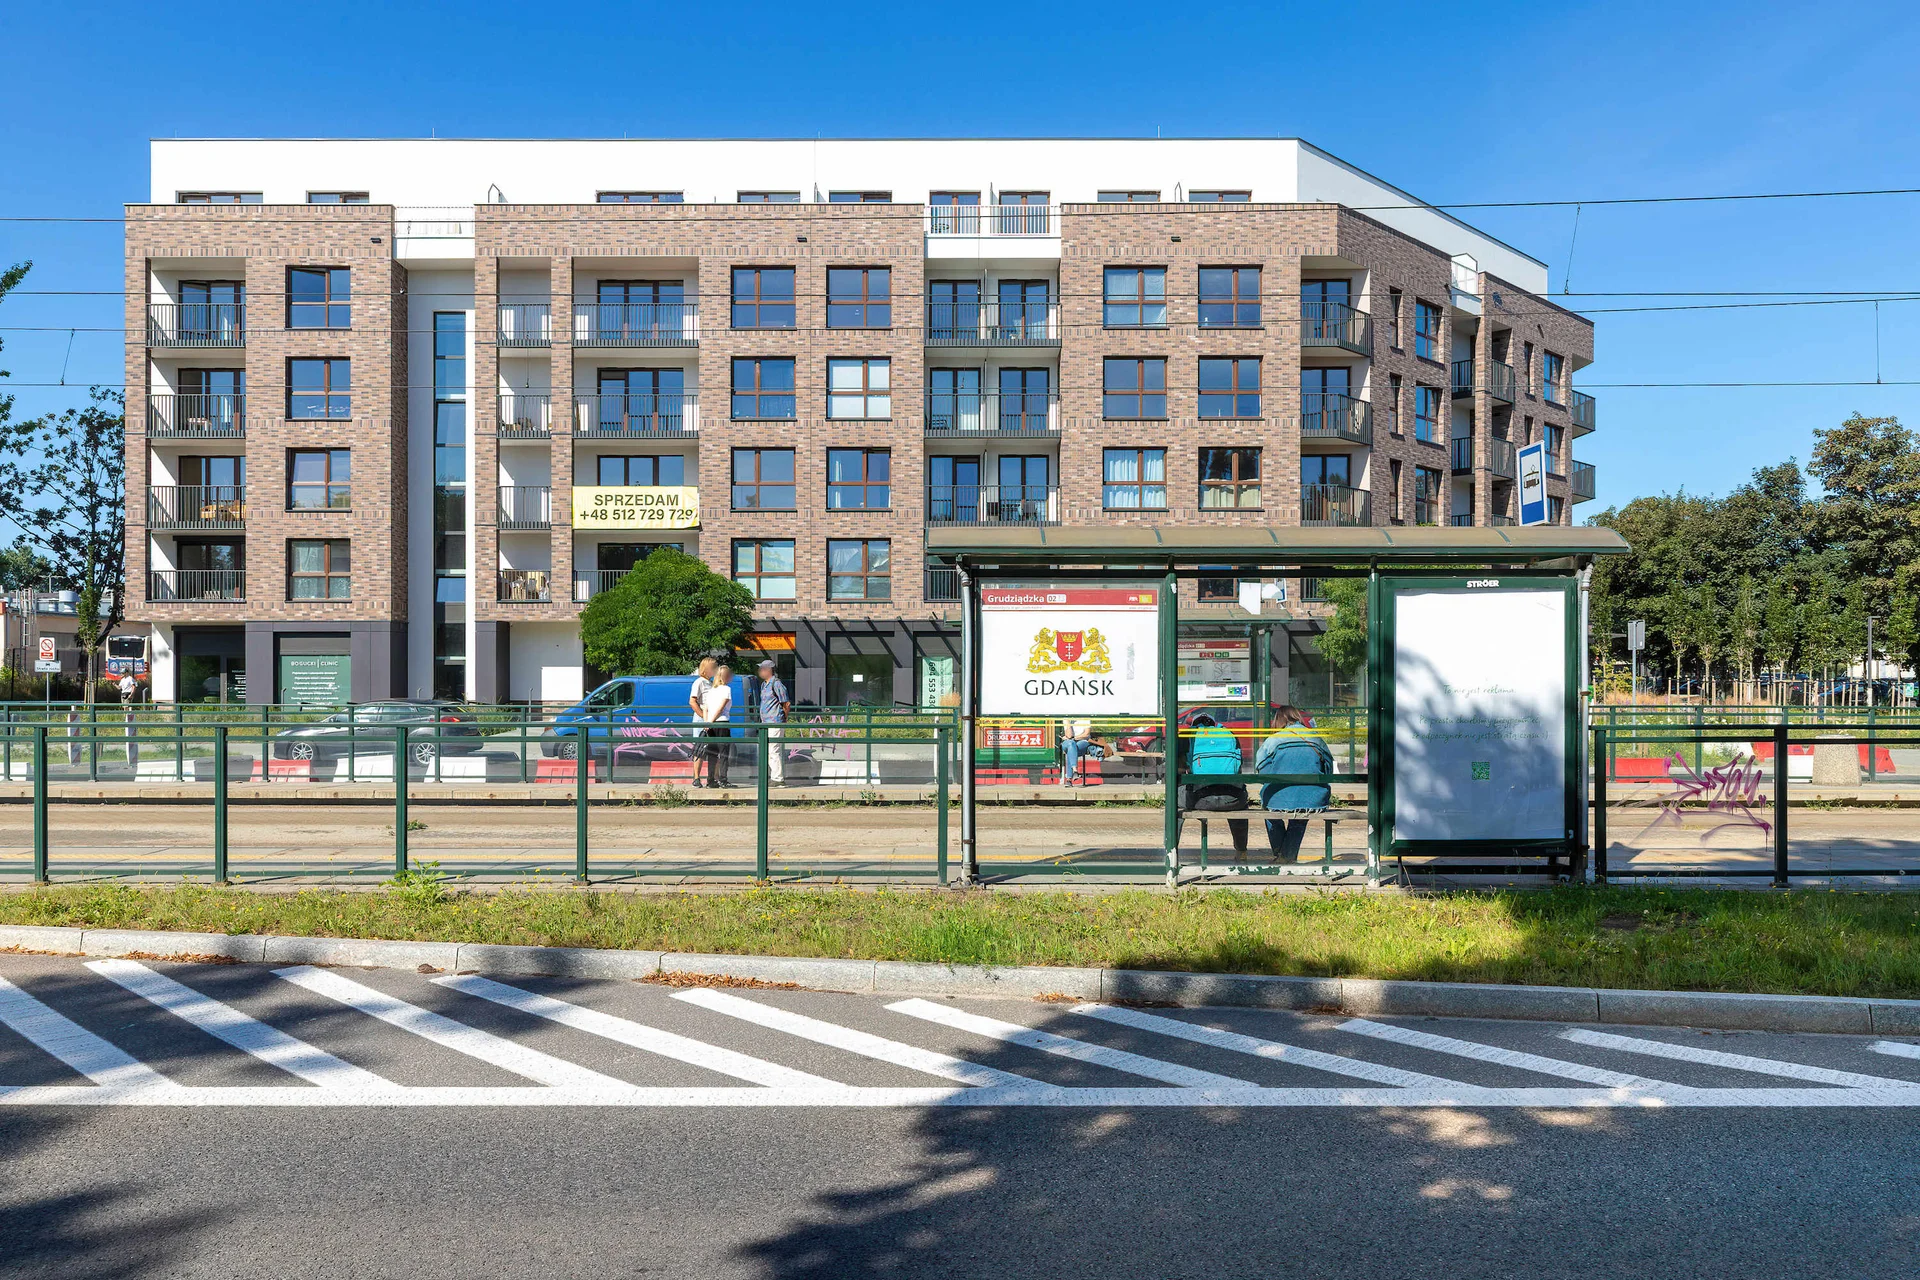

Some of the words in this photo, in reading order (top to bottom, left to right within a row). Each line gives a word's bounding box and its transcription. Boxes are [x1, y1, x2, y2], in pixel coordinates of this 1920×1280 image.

[594, 494, 679, 506] SPRZEDAM
[580, 508, 608, 520] +48
[612, 508, 636, 520] 512
[640, 508, 665, 520] 729
[669, 508, 694, 520] 729
[1466, 579, 1500, 588] STRÖER
[987, 594, 1045, 605] Grudziądzka
[928, 661, 936, 676] 694
[928, 678, 936, 693] 553
[1024, 676, 1114, 696] GDAŃSK
[1443, 684, 1451, 694] To
[1465, 686, 1480, 699] jest
